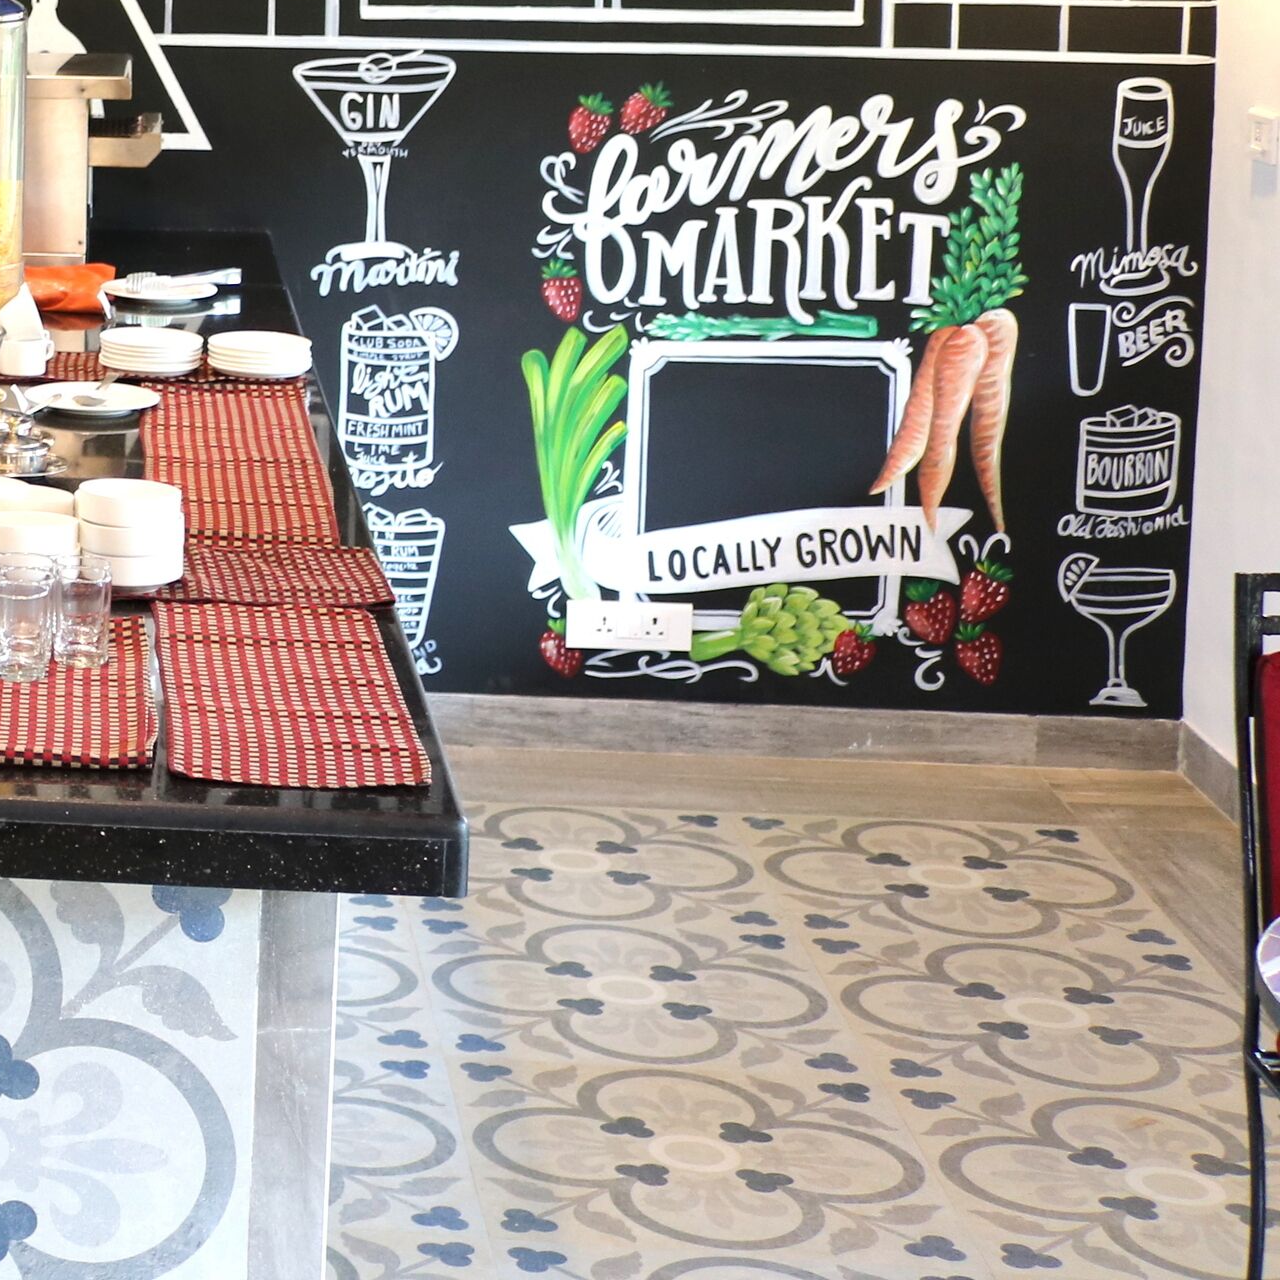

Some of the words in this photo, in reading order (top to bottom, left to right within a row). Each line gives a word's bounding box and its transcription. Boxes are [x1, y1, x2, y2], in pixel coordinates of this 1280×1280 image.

[340, 91, 401, 131] GIN
[1122, 115, 1166, 137] JUICE
[640, 176, 951, 325] MARKET
[1070, 243, 1199, 289] Mimosa
[351, 336, 384, 348] CLUB
[391, 337, 422, 349] SODA
[1118, 308, 1192, 359] BEER
[368, 380, 430, 419] RUM
[1086, 448, 1171, 491] BOURBON
[1057, 513, 1095, 539] Old
[647, 536, 783, 583] LOCALLY
[796, 524, 922, 569] GROWN
